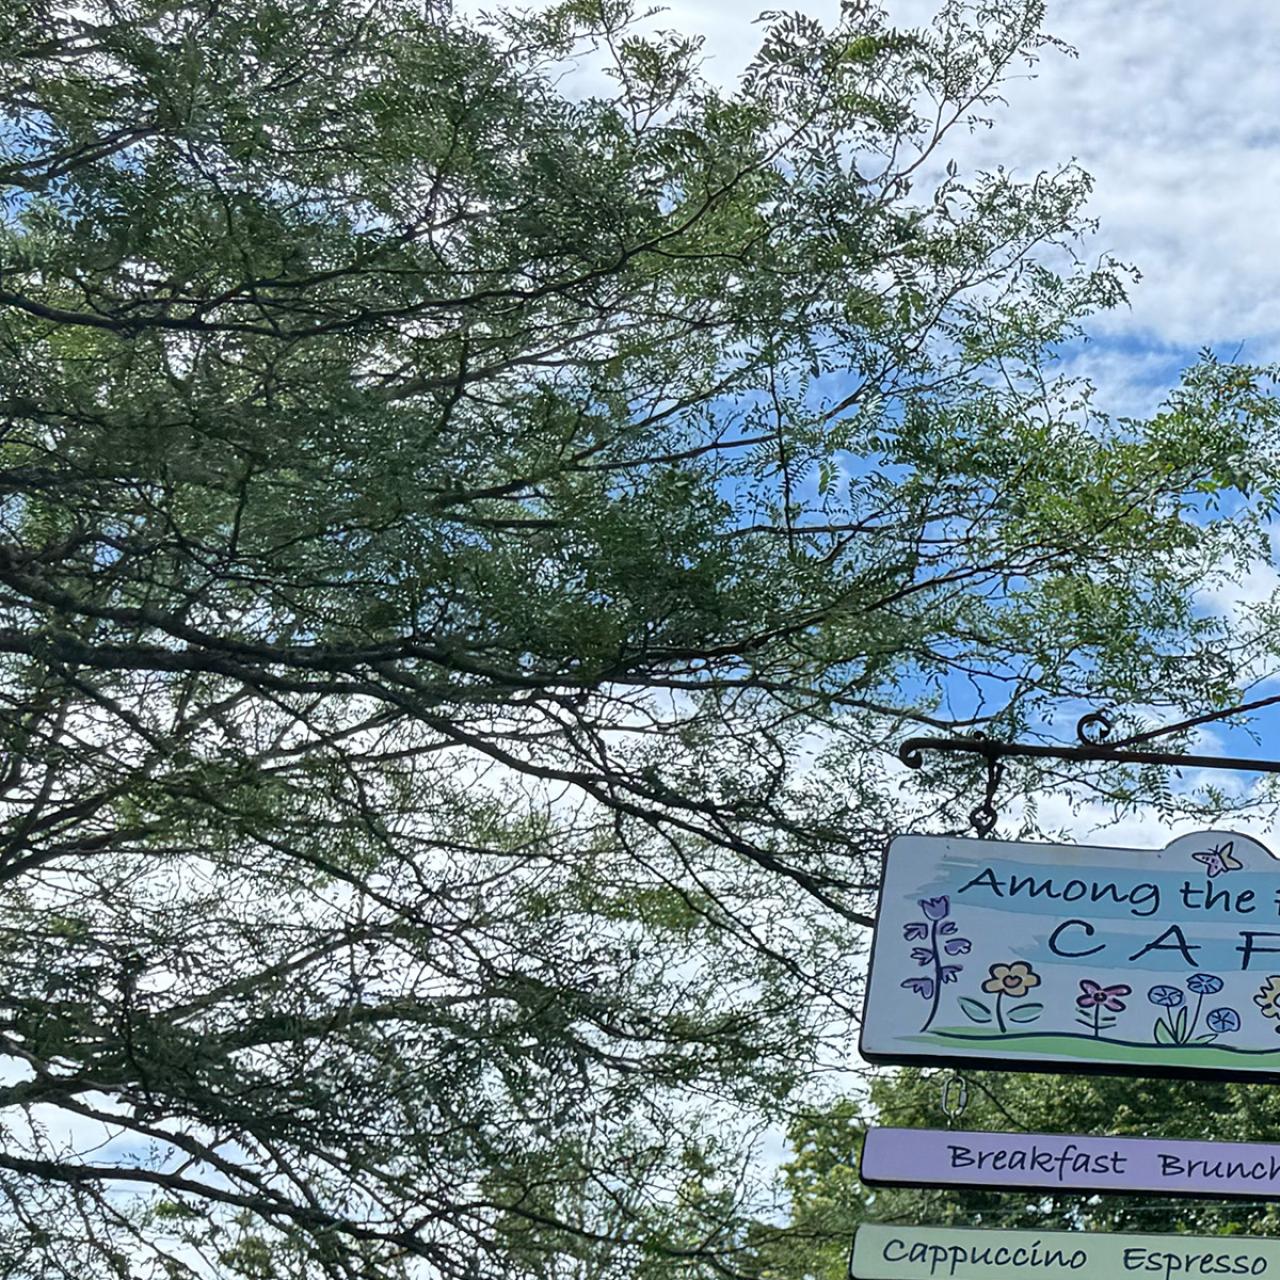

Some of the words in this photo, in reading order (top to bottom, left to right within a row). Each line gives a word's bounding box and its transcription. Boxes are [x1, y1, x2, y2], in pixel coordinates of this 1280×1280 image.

[957, 865, 1161, 917] Among
[1179, 877, 1257, 915] the
[946, 1144, 1128, 1177] Breakfast
[882, 1238, 1088, 1276] Cappuccino
